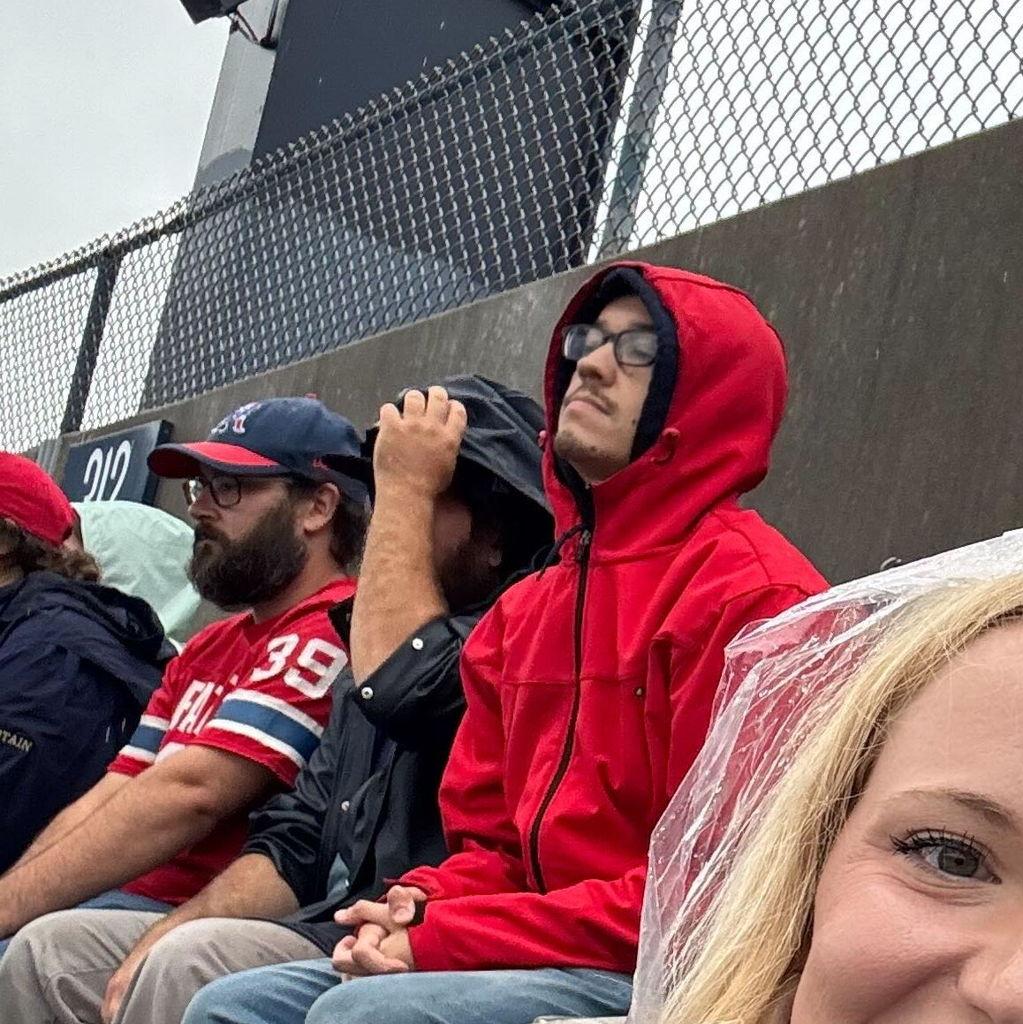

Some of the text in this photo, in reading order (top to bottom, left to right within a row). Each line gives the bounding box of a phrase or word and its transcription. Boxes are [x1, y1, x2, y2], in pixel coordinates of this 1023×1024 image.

[83, 440, 131, 502] 212
[251, 633, 348, 699] 39
[0, 729, 33, 752] TAIN
